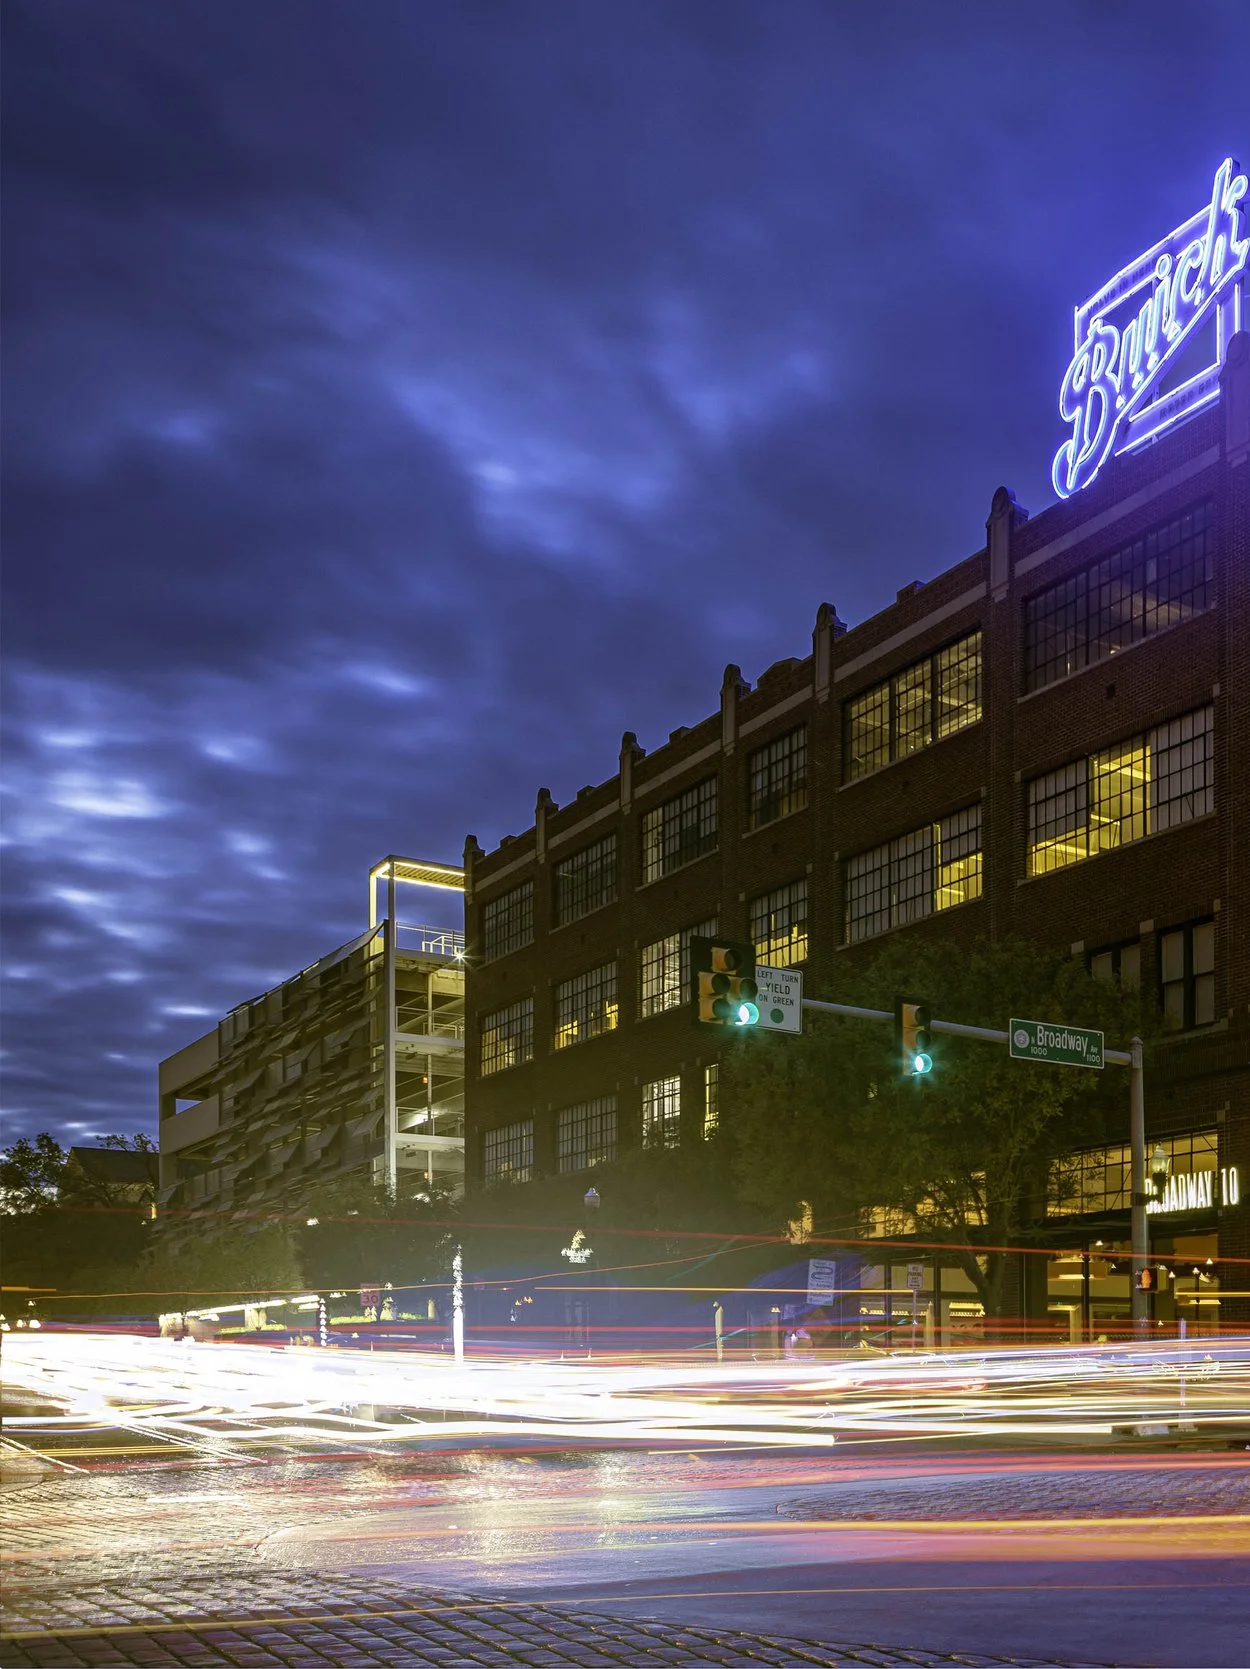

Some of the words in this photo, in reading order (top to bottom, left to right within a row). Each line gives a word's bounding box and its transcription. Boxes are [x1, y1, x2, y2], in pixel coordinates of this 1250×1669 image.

[1052, 156, 1250, 499] Buick
[757, 970, 773, 980] LEFT
[781, 974, 799, 984] TURN
[765, 982, 791, 995] YIELD
[758, 993, 768, 1002] ON
[772, 996, 794, 1006] GREEN
[1037, 1025, 1088, 1057] Broadway
[1030, 1046, 1048, 1056] 1000
[1086, 1054, 1101, 1063] 1100
[1221, 1167, 1239, 1206] 10
[361, 1294, 379, 1305] 30
